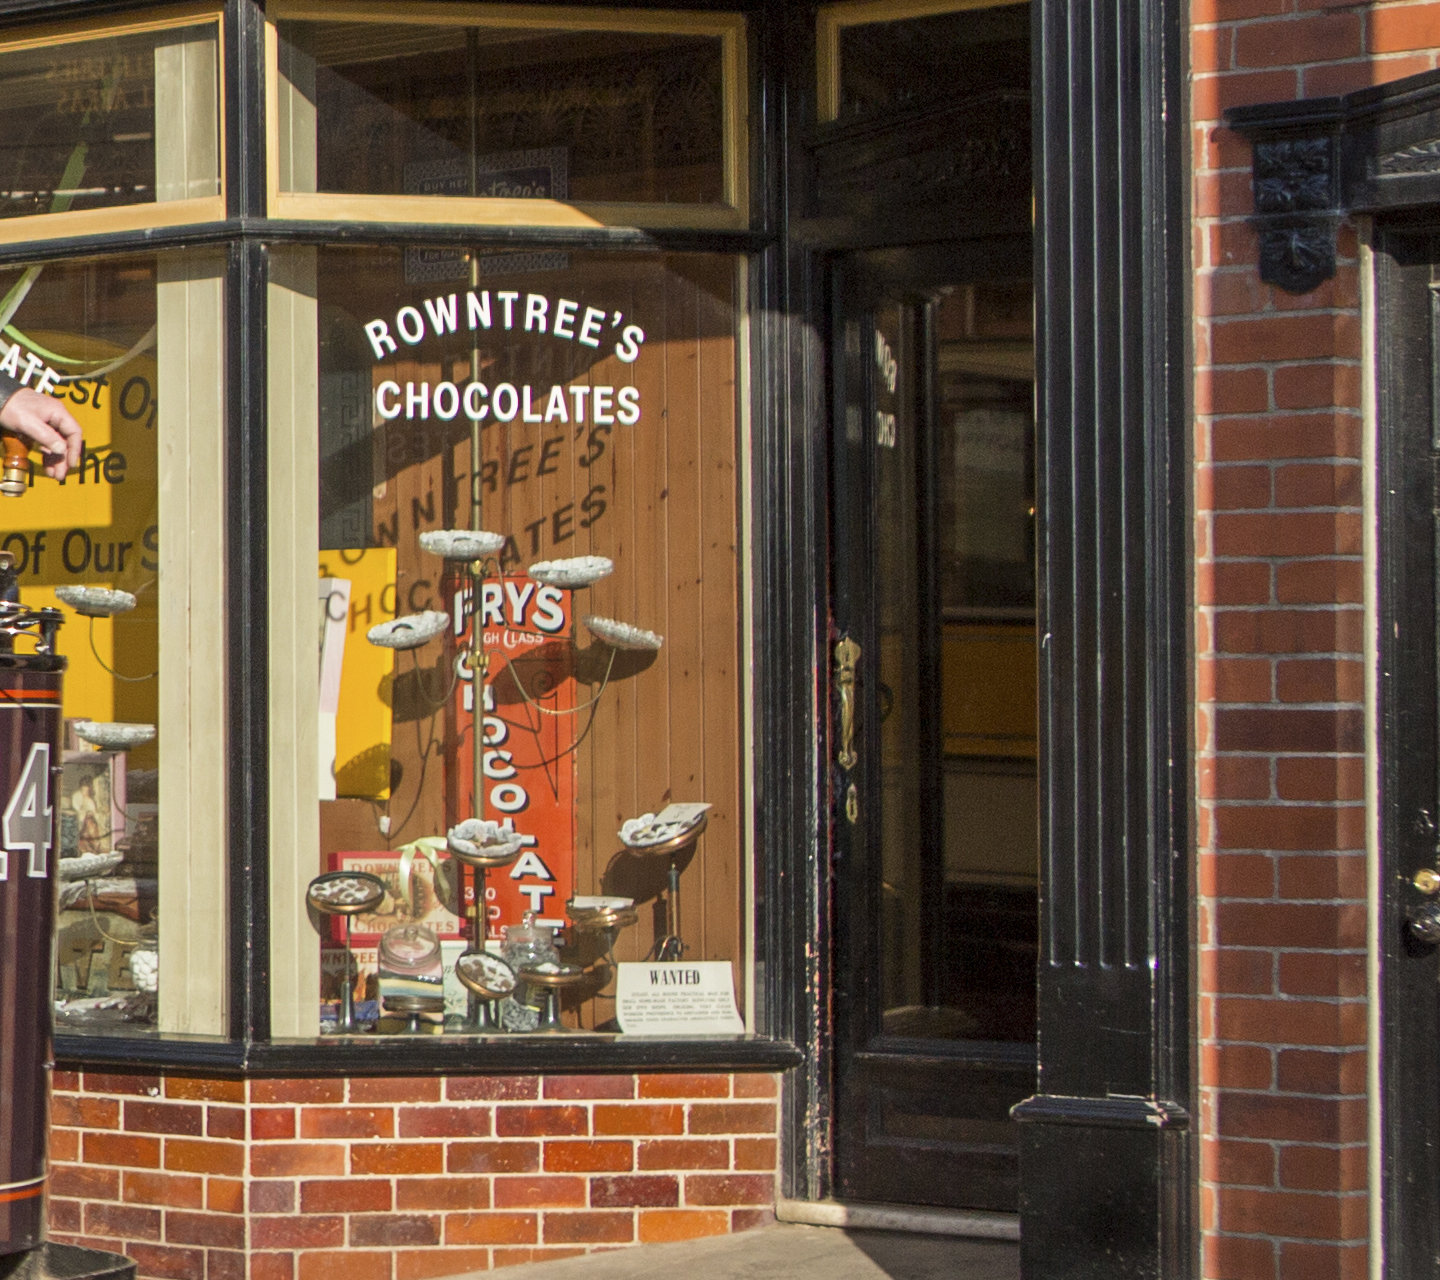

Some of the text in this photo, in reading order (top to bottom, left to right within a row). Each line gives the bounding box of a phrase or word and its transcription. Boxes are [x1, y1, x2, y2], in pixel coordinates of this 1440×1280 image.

[364, 291, 645, 363] ROWNTREE'S
[376, 380, 641, 426] CHOCOLATES
[62, 528, 131, 573] Our
[650, 969, 701, 985] WANTED
